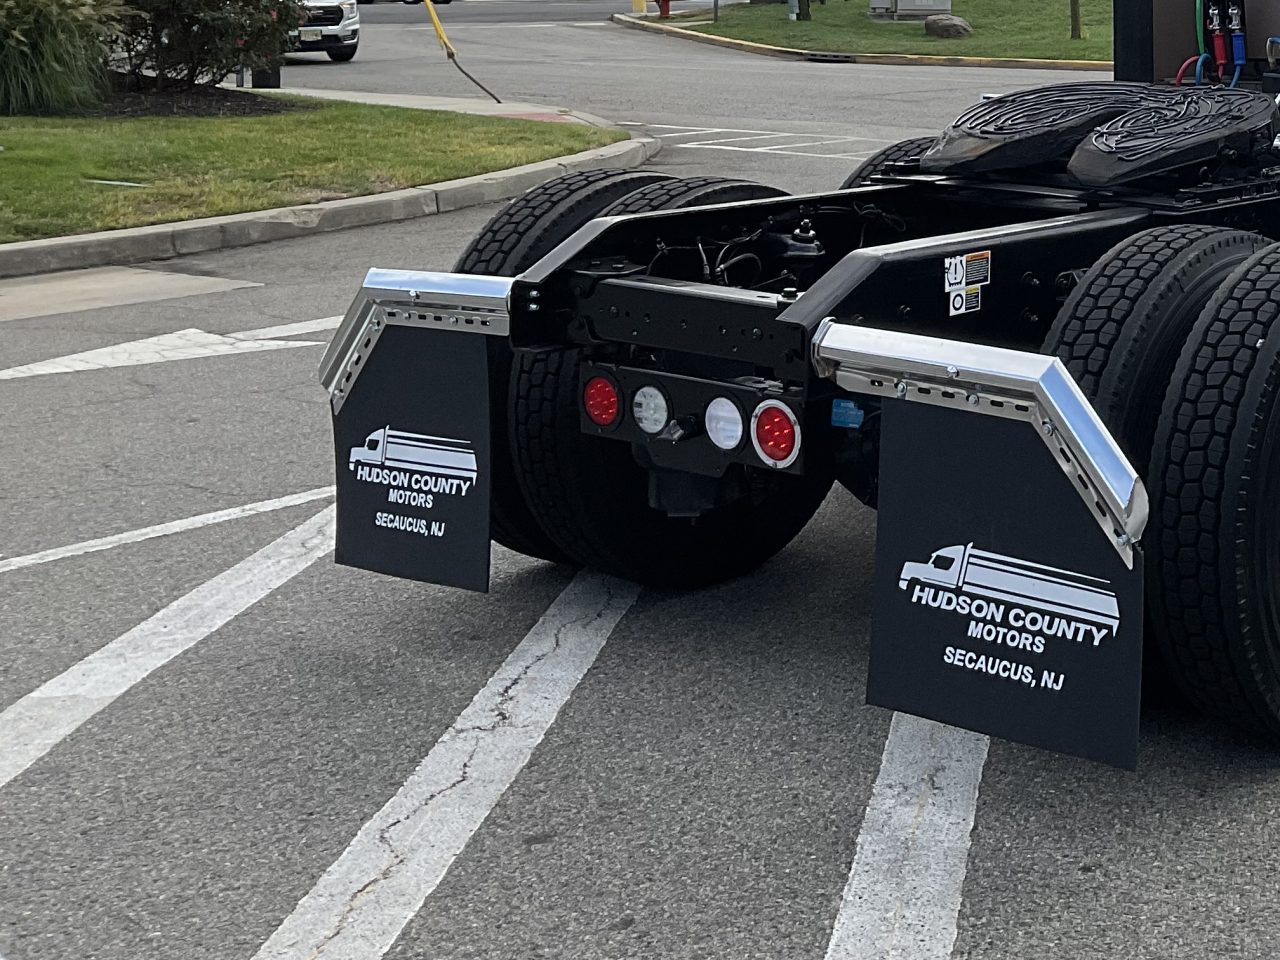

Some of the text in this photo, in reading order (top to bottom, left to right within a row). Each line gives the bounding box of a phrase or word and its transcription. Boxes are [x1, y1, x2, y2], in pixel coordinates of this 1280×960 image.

[357, 465, 471, 496] HUDSON COUNTY
[388, 488, 434, 508] MOTORS
[375, 512, 446, 537] SECAUCUS, NJ
[911, 585, 1108, 646] HUDSON COUNTY
[967, 620, 1046, 653] MOTORS
[943, 646, 1065, 690] SECAUCUS, NJ
